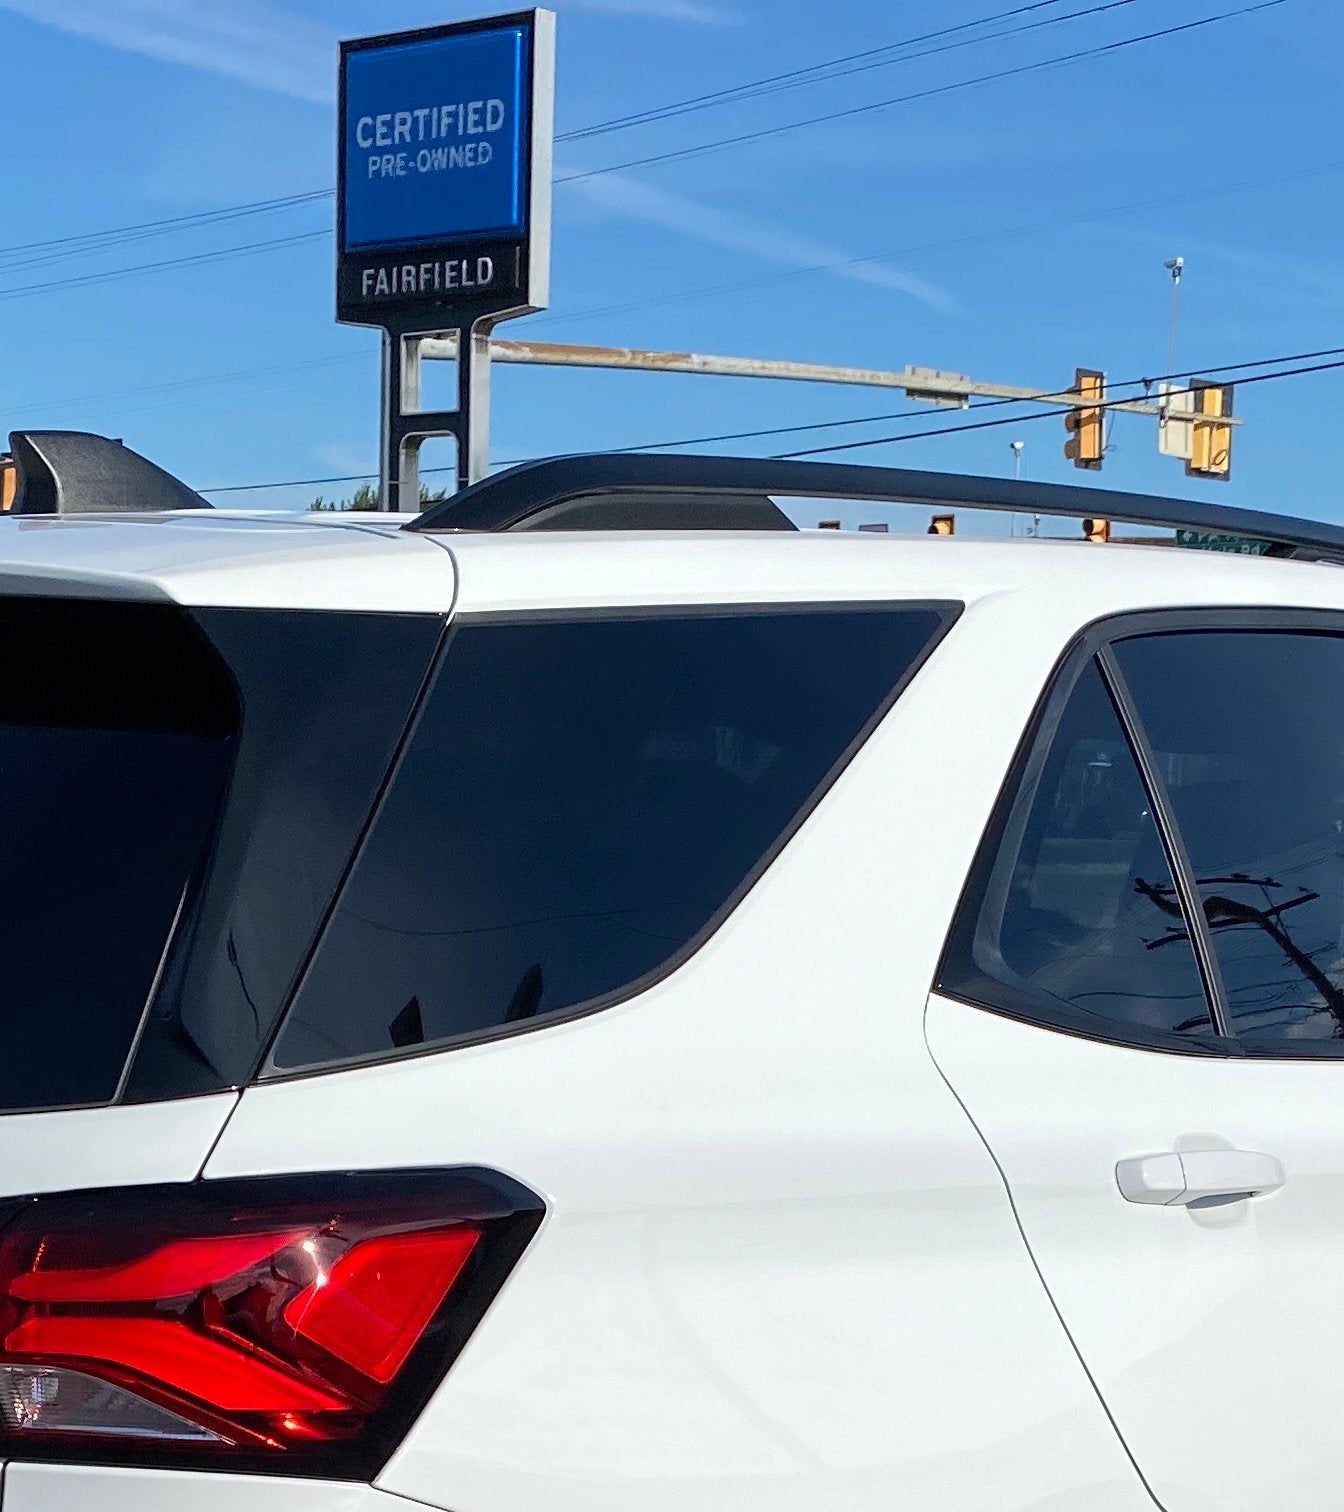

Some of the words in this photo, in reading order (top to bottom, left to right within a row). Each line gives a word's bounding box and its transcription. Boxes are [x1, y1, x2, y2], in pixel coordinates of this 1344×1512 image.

[356, 98, 505, 149] CERTIFIED
[367, 142, 493, 179] PRE-OWNED
[361, 257, 493, 296] FAIRFIELD
